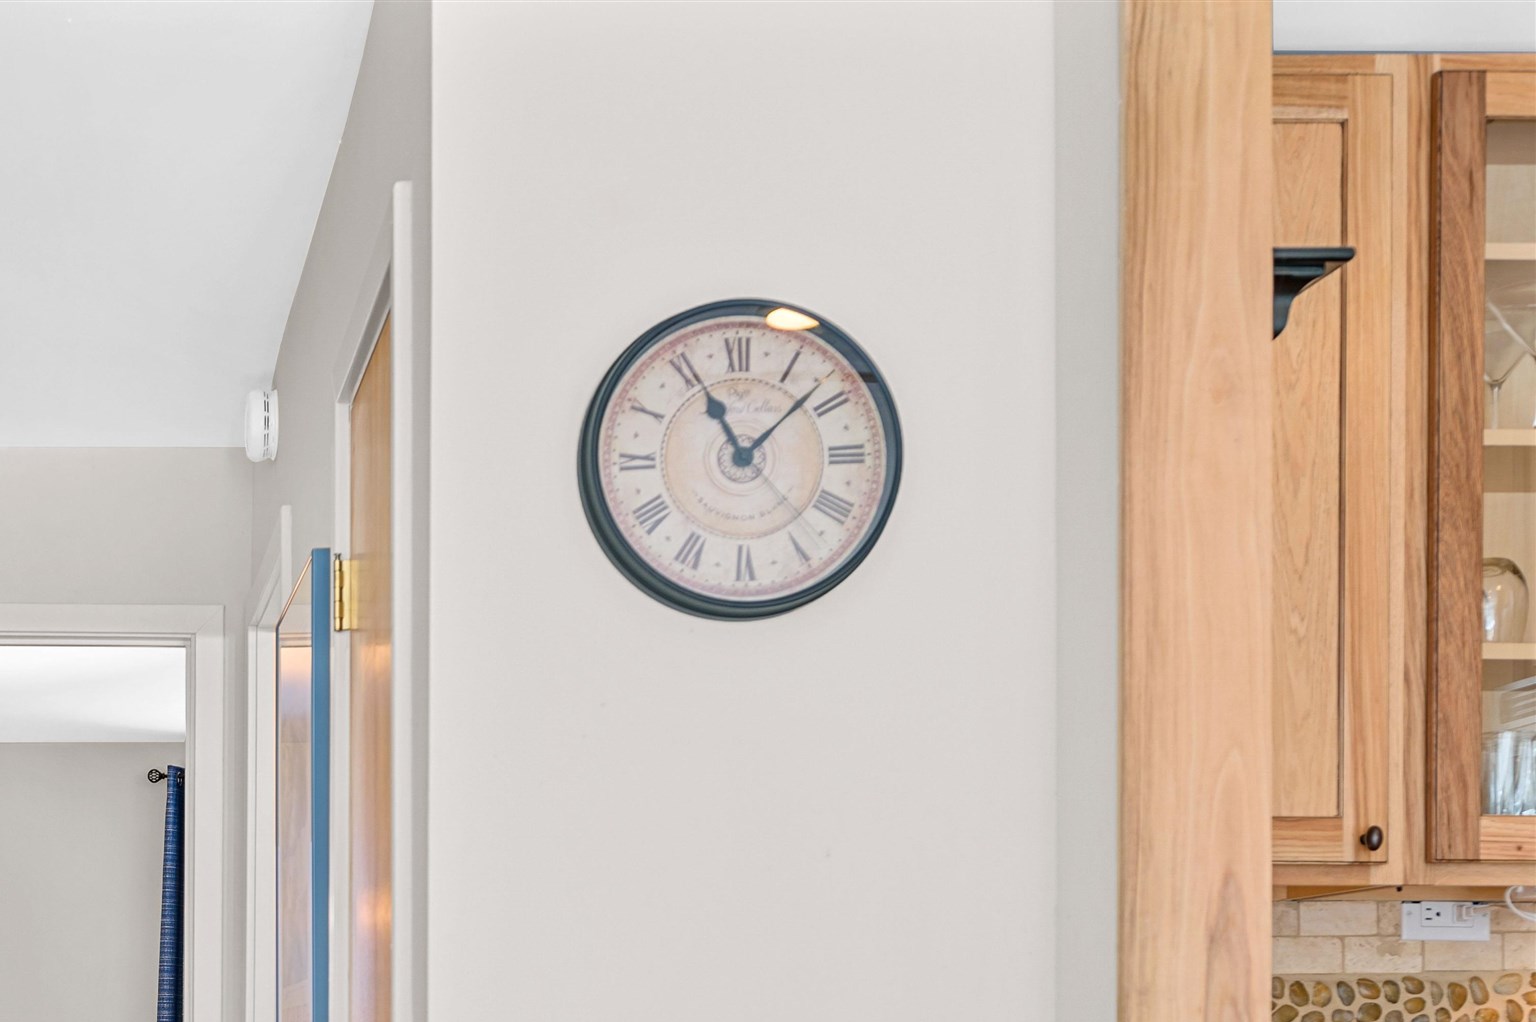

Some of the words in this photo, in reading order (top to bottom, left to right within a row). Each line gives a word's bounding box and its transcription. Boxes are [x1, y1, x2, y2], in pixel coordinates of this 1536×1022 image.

[724, 337, 751, 373] XII
[631, 400, 665, 424] X
[813, 390, 850, 418] II
[619, 451, 657, 472] IX
[828, 444, 866, 465] III
